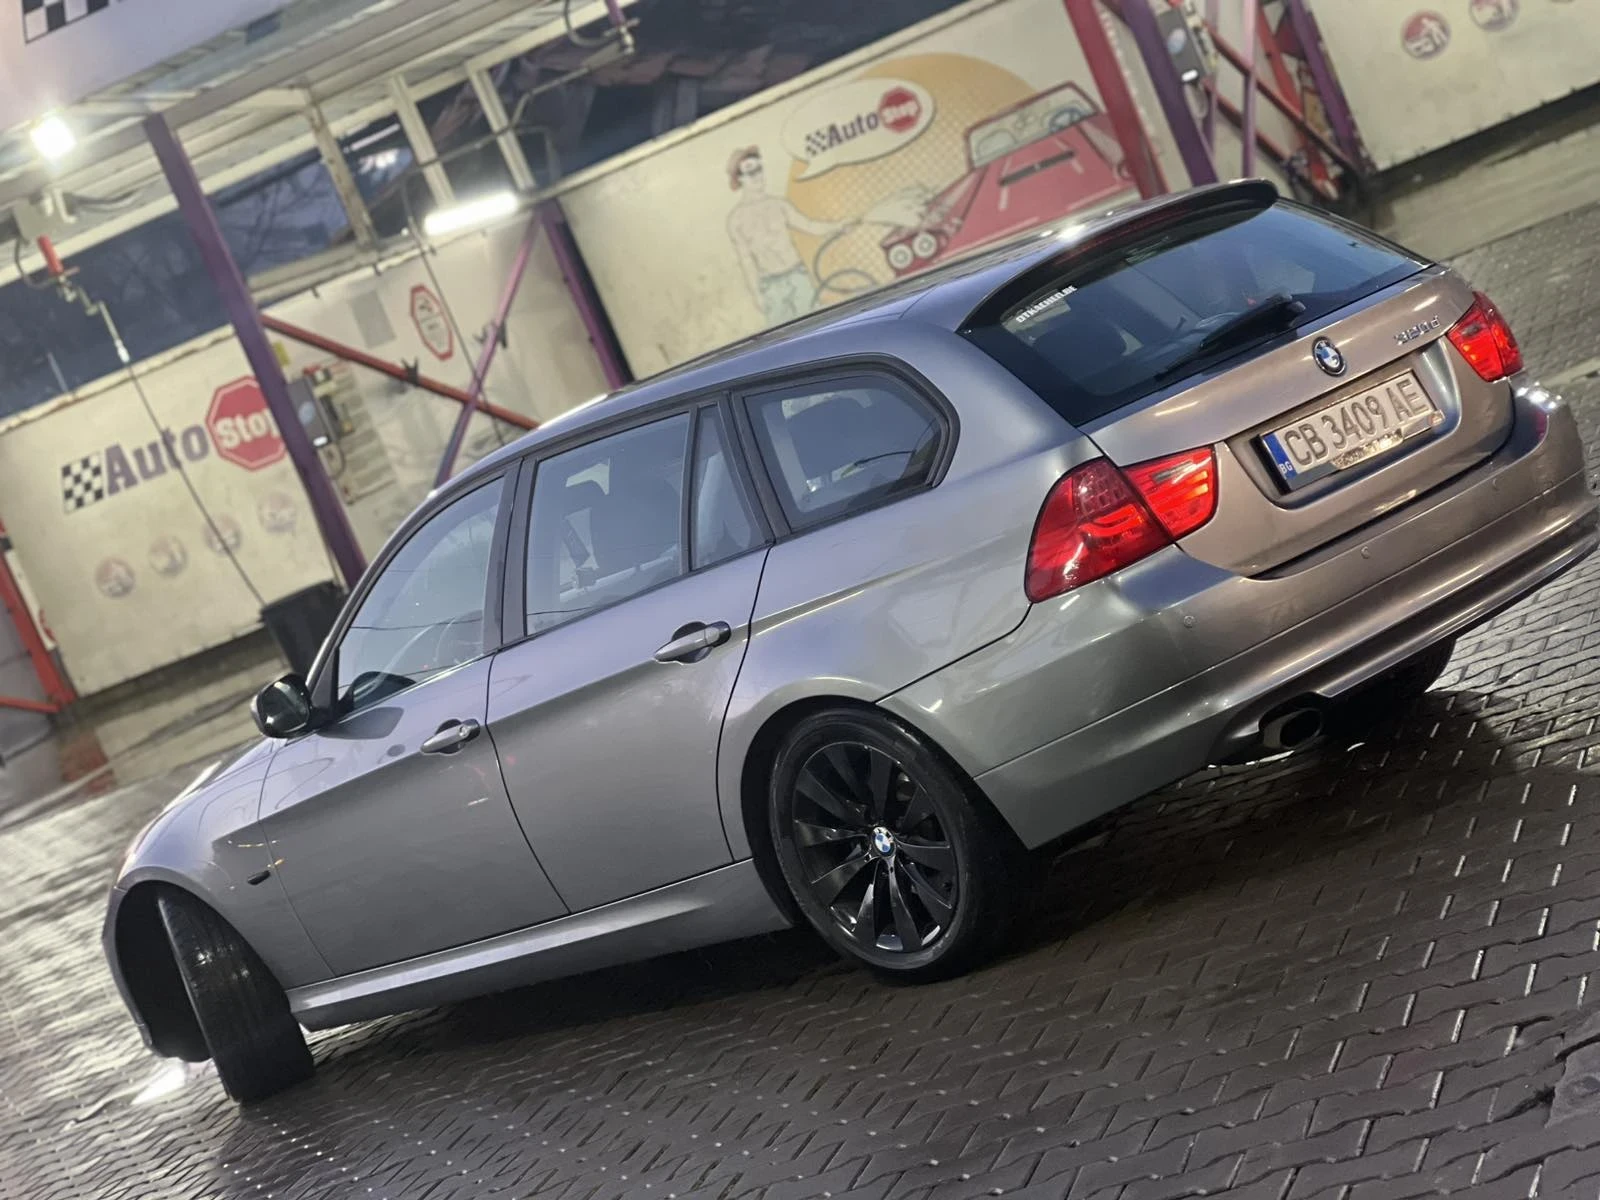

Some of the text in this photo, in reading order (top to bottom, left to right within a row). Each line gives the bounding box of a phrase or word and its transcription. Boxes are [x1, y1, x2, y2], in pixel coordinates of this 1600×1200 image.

[825, 112, 879, 148] Auto
[1284, 423, 1328, 465] CB
[1321, 395, 1388, 449] 3409
[1386, 379, 1429, 422] AE
[104, 423, 210, 496] Auto
[1279, 461, 1293, 474] BG
